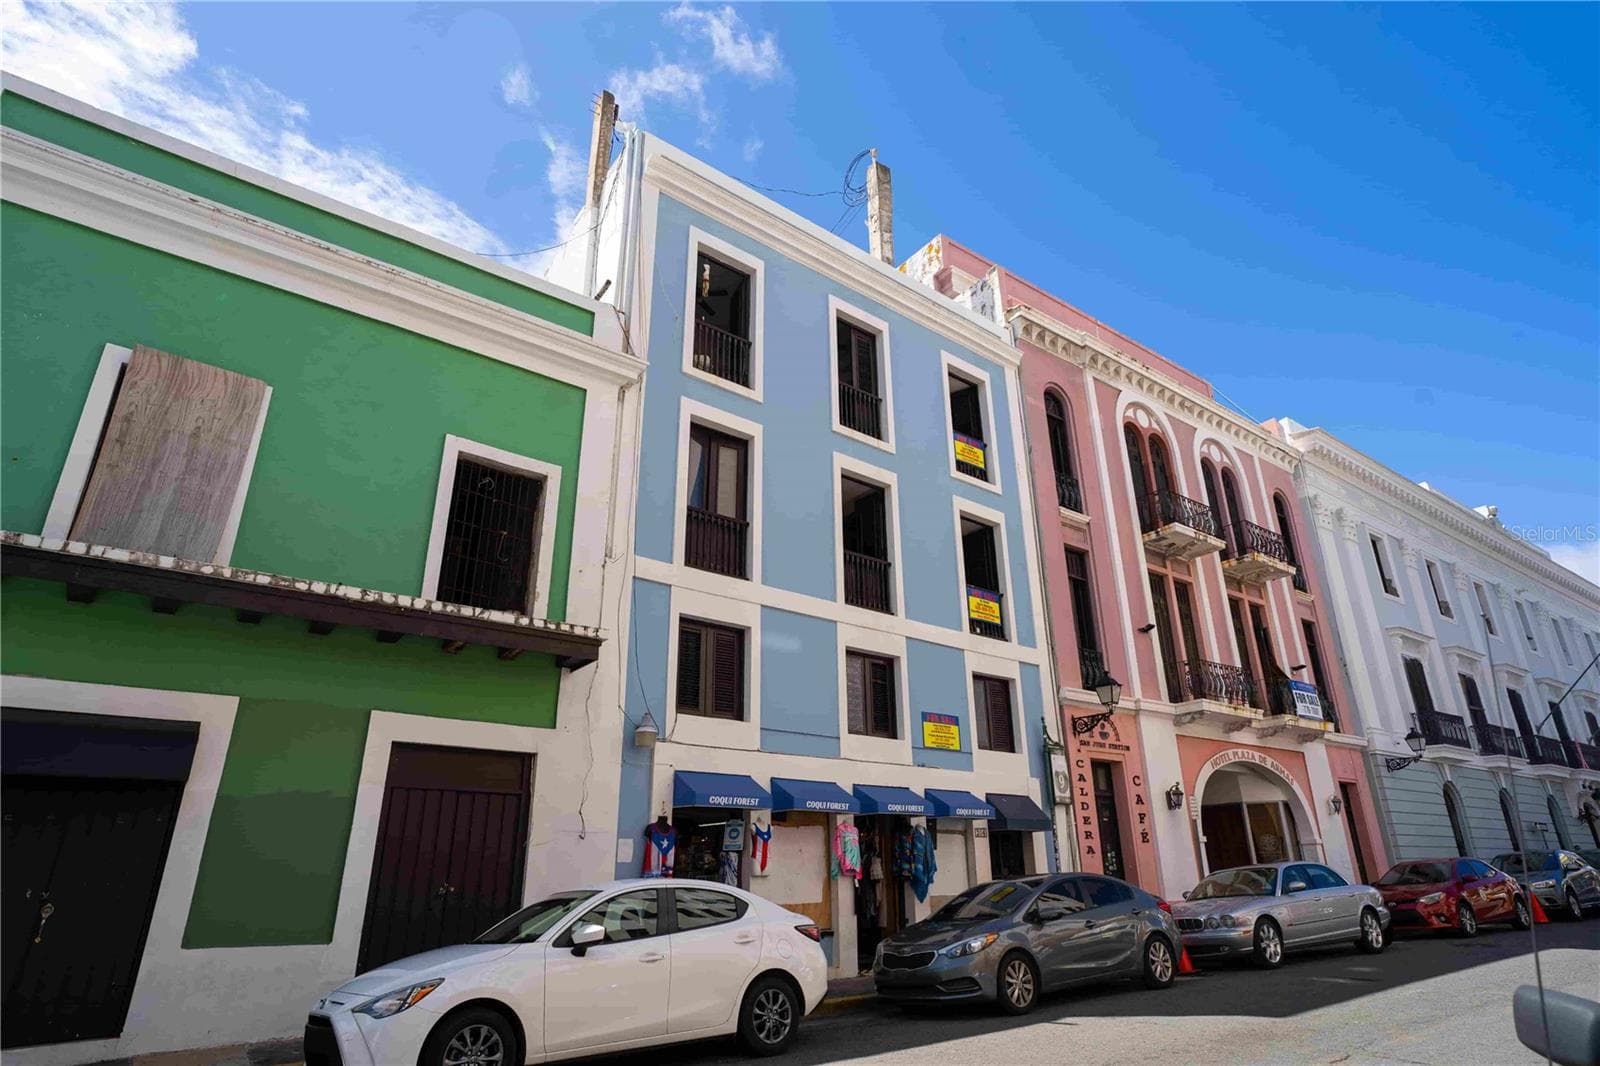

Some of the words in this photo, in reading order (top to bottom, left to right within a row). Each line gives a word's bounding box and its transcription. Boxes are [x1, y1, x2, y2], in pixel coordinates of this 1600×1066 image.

[1294, 692, 1308, 705] FOR
[1210, 752, 1233, 769] HOTEL
[1232, 750, 1257, 762] PLAZA
[1258, 754, 1268, 766] DE
[709, 795, 732, 806] COQUI
[733, 796, 760, 807] FOREST
[806, 800, 826, 810] COQUI
[827, 801, 849, 811] FOREST
[1075, 759, 1096, 855] CALDERA
[887, 803, 905, 812] COQUI
[905, 804, 924, 813] FOREST
[1132, 775, 1150, 844] CAFÉ
